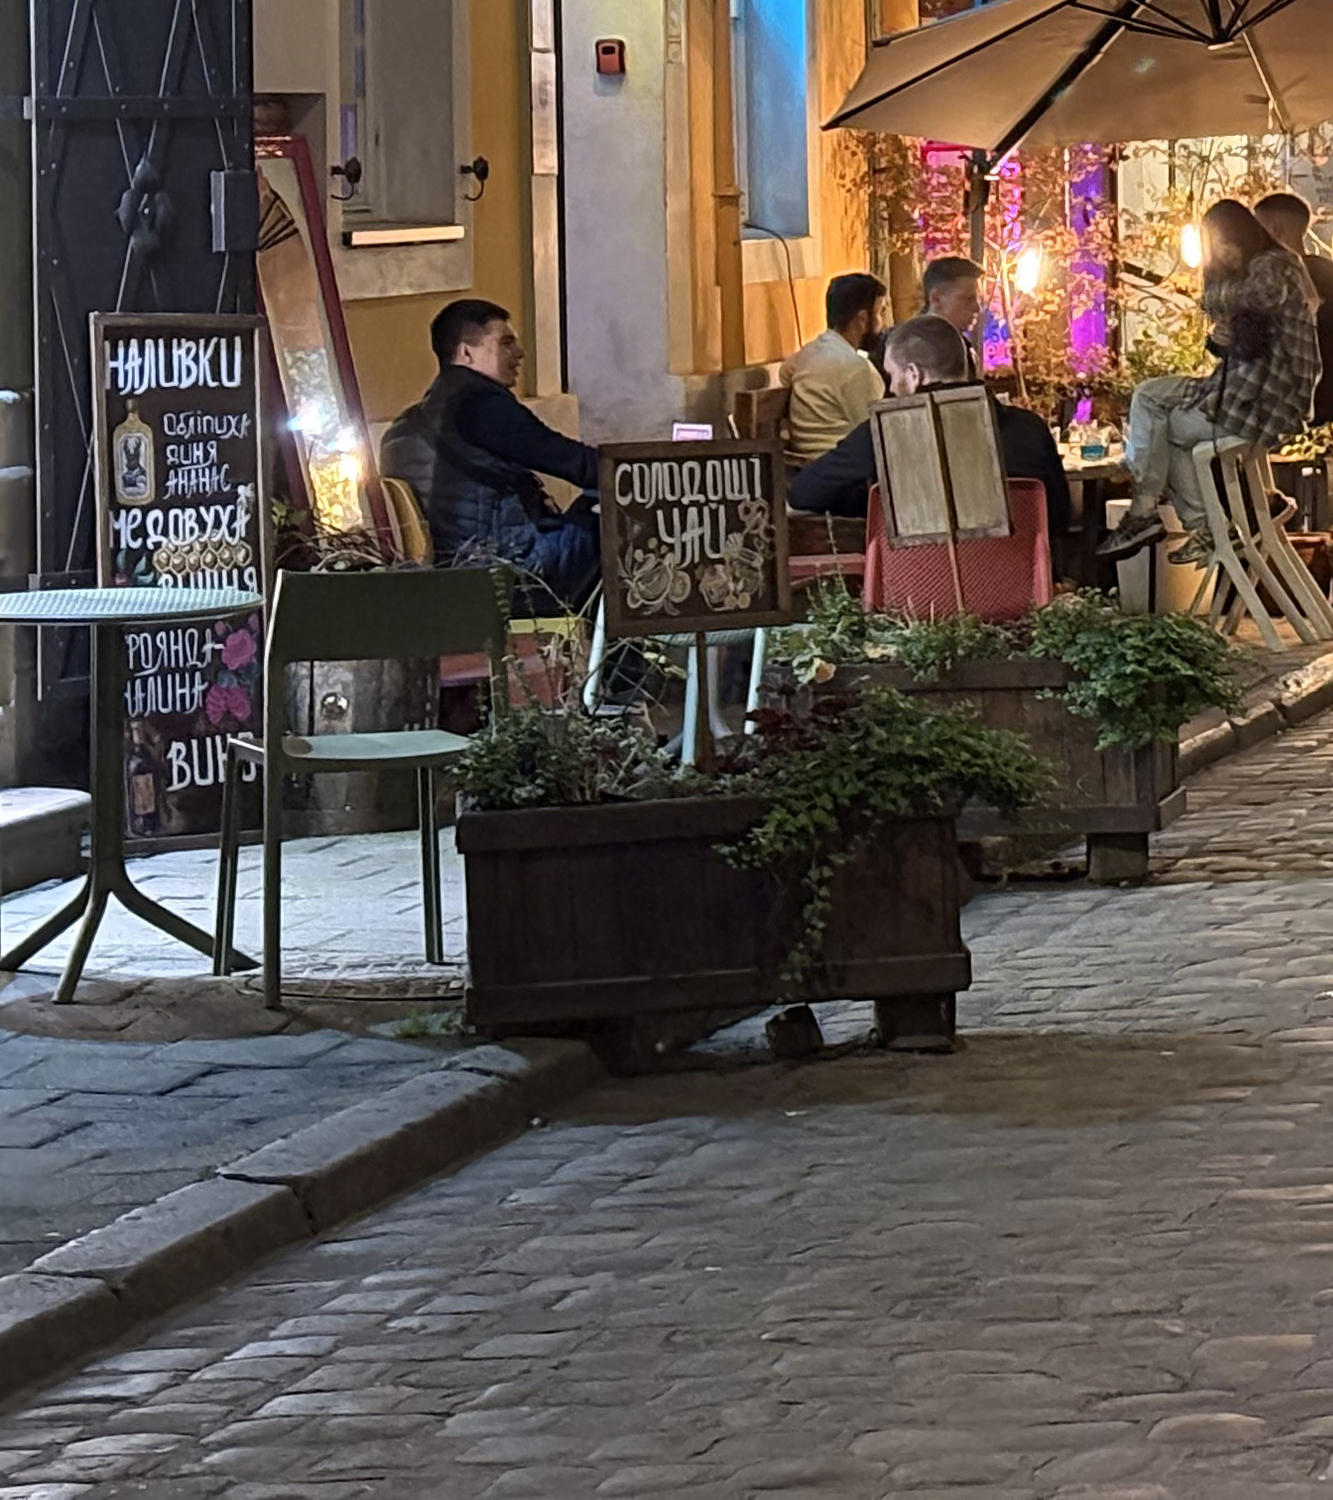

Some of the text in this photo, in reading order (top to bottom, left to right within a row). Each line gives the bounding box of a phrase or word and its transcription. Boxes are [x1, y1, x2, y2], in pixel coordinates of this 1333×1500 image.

[104, 336, 242, 395] НАЛИВКИ
[166, 440, 217, 469] ДИНЯ
[163, 464, 231, 499] АНАНАС
[615, 456, 762, 509] СОЛОДОЩІ
[656, 502, 726, 568] ЧАЙ
[125, 628, 225, 677] РОЯНДА
